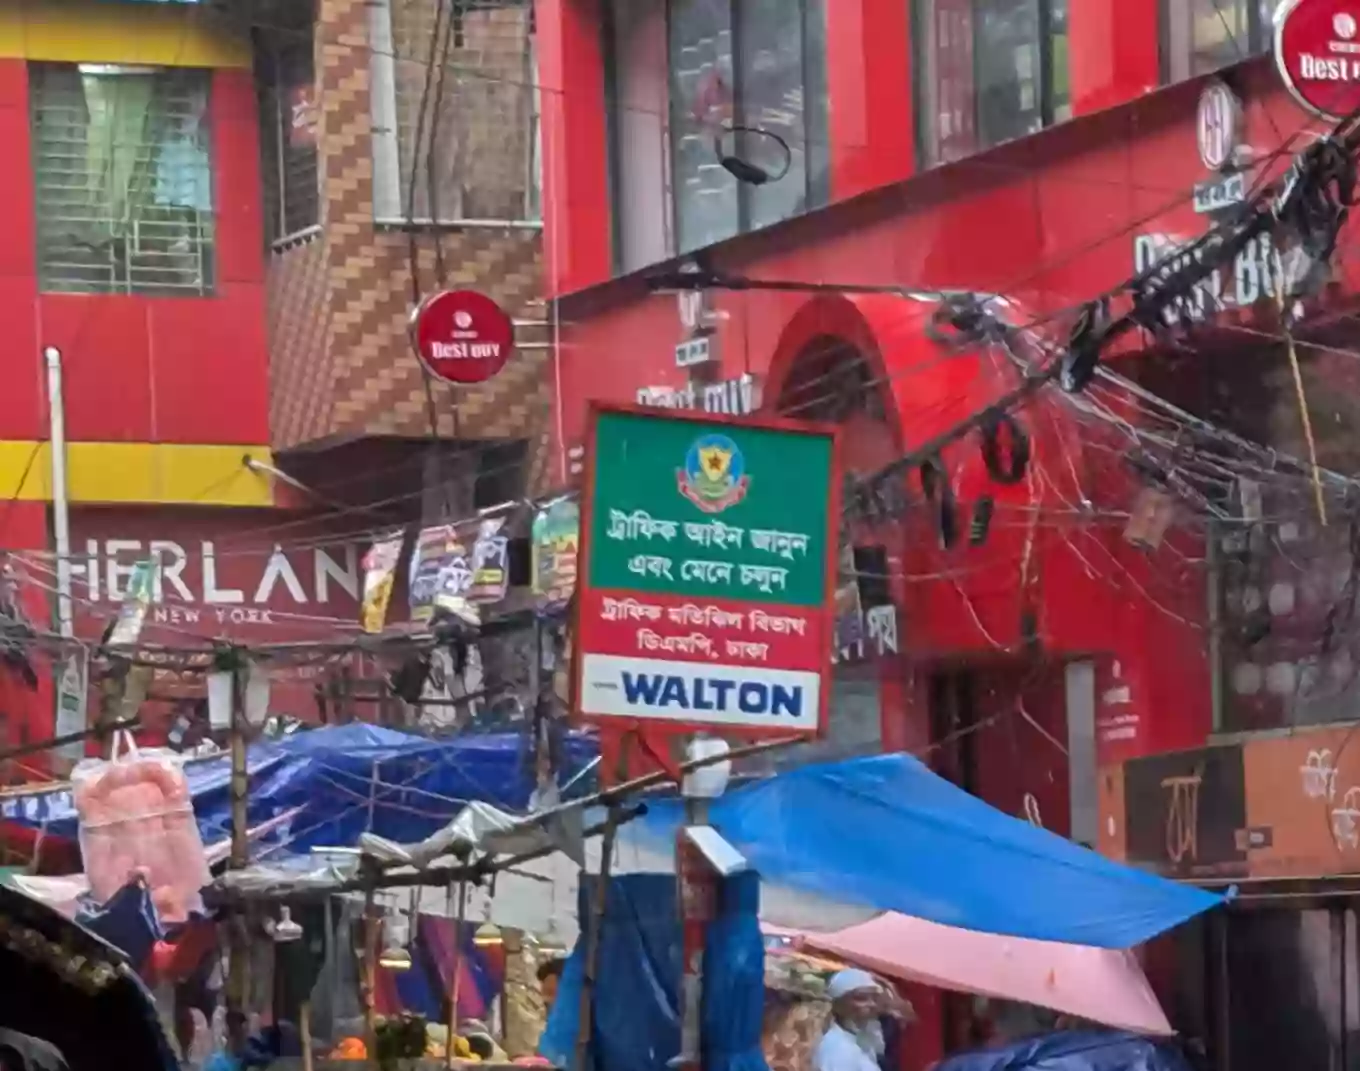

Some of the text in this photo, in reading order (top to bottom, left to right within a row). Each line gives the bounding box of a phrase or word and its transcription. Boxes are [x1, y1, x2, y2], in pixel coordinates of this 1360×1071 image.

[606, 508, 811, 560] ট্রাফিক আইন জানুন
[627, 554, 789, 594] এবং মেনে চলুন
[154, 606, 199, 624] NEW
[621, 670, 803, 718] WALTON
